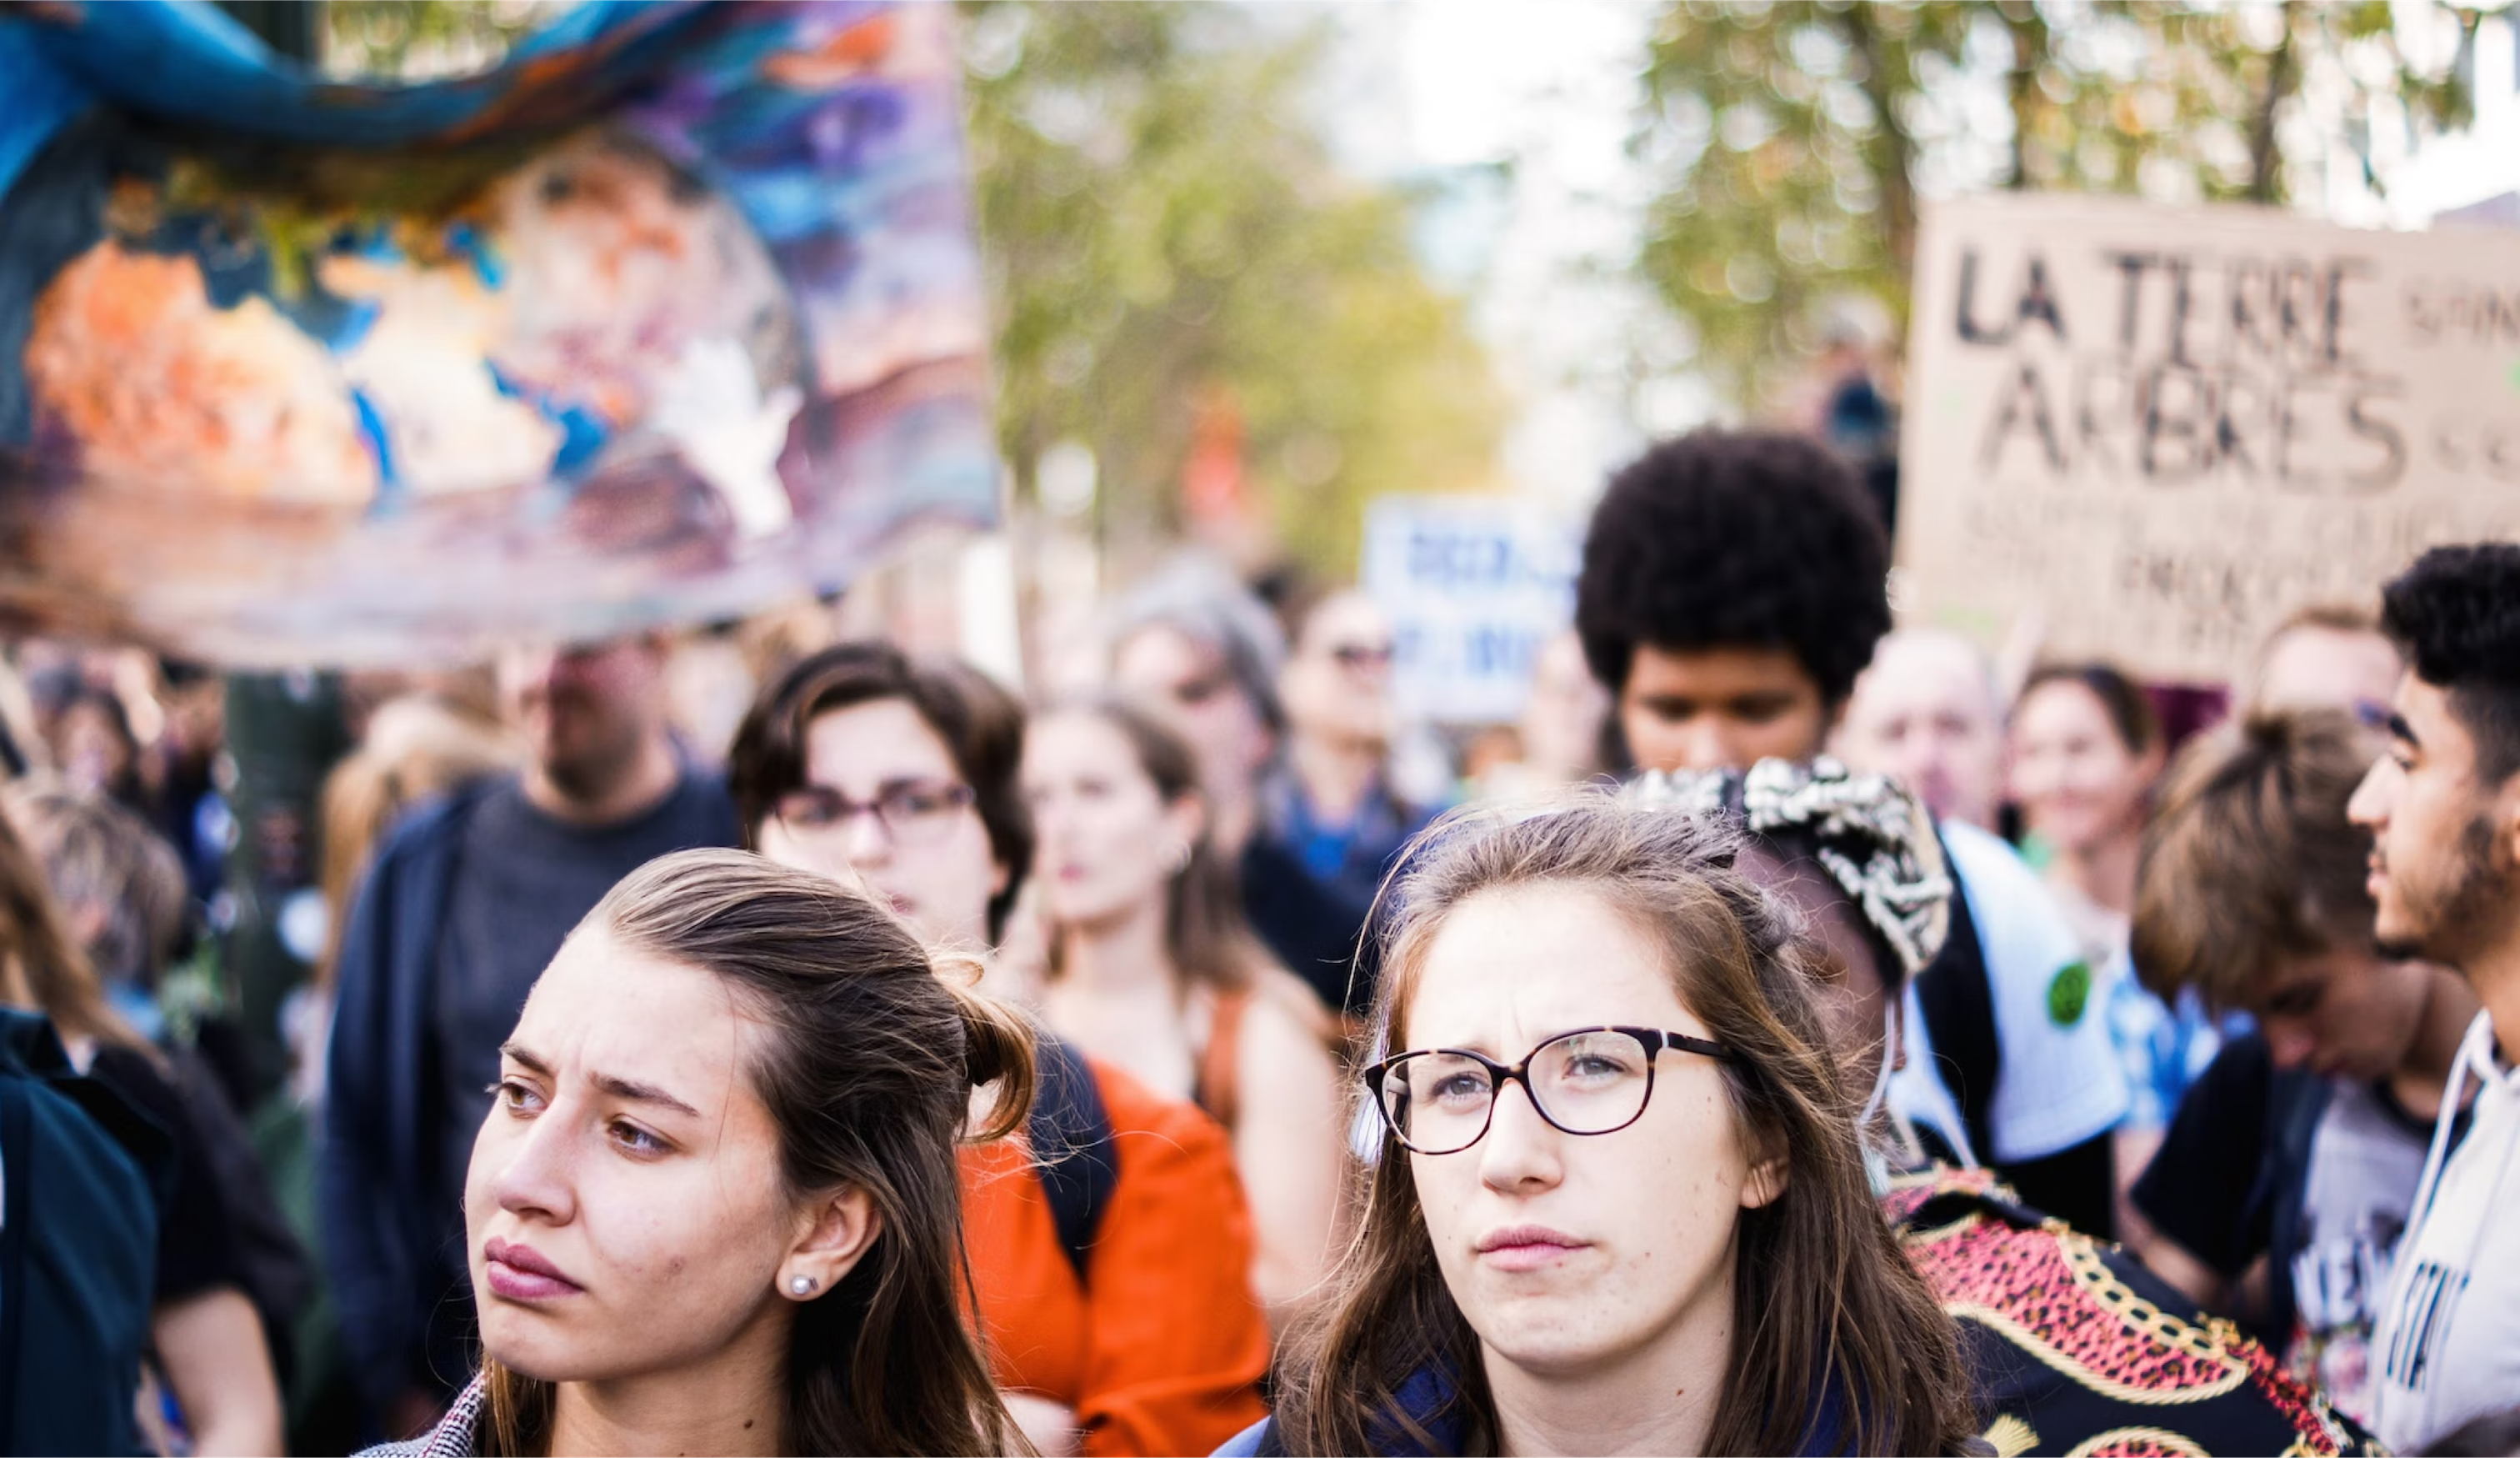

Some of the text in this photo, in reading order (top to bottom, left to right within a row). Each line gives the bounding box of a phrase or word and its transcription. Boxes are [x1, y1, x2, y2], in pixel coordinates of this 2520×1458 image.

[1955, 243, 2068, 345] LA
[2098, 248, 2380, 369] TERRE
[1973, 355, 2410, 498] ARBRES
